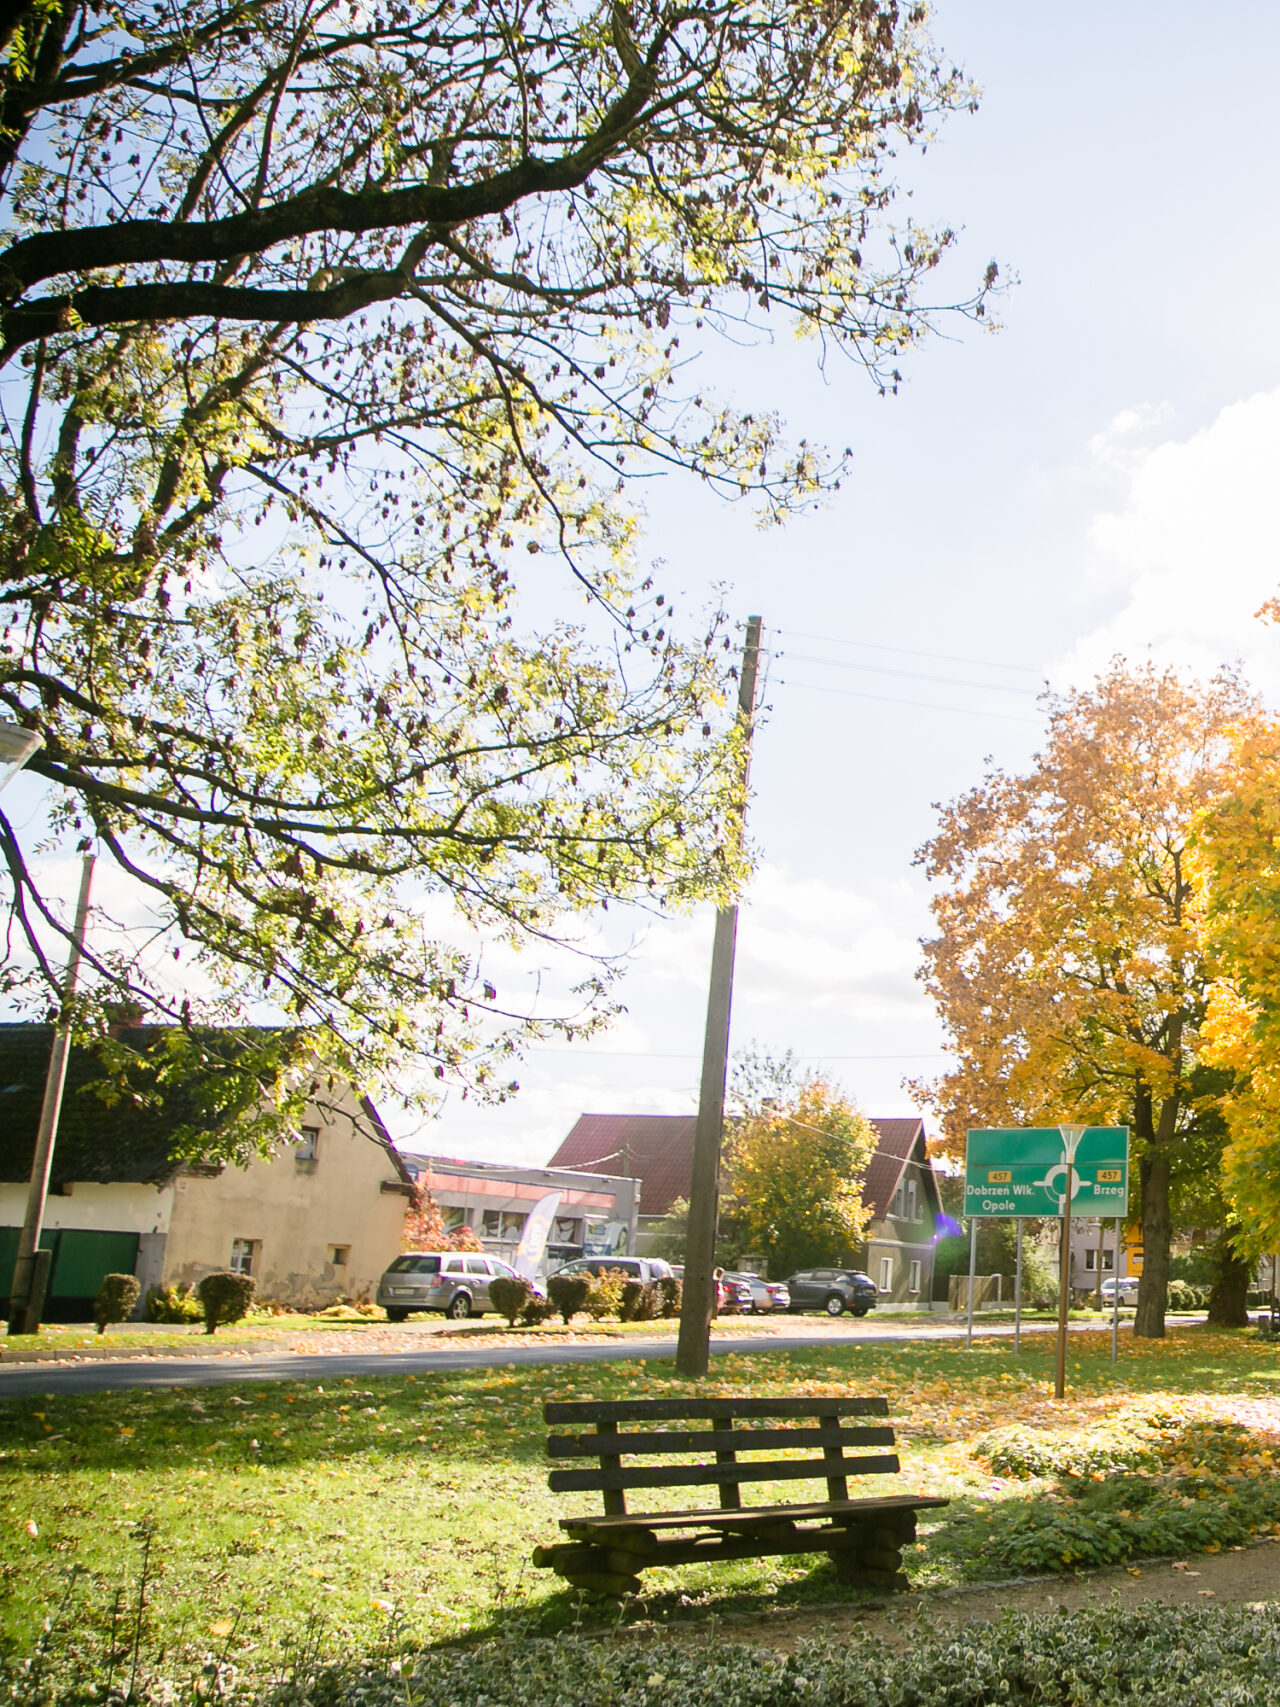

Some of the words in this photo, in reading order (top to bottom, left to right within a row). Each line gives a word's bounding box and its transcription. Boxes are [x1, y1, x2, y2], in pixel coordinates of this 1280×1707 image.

[992, 1172, 1008, 1181] 457
[1101, 1172, 1118, 1180] 457
[1013, 1184, 1036, 1195] Wlk.
[1094, 1184, 1124, 1197] Brzeg
[982, 1199, 1016, 1213] Opole
